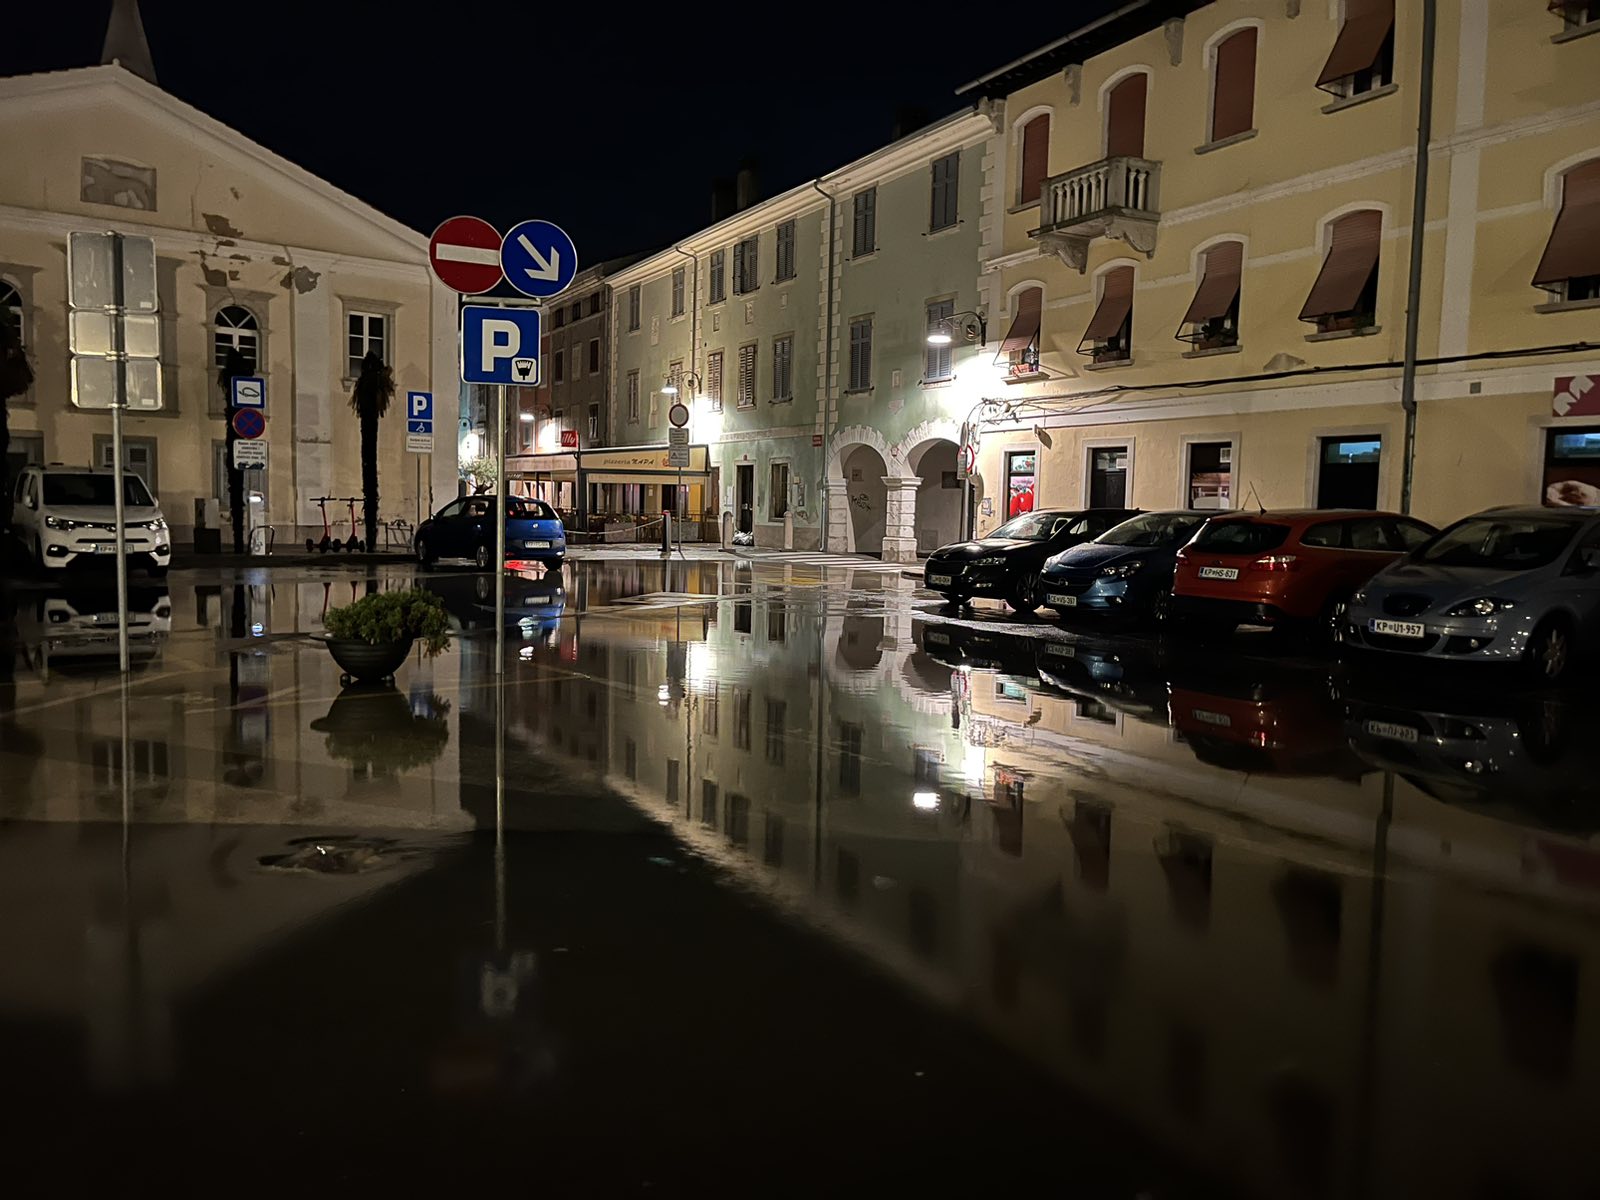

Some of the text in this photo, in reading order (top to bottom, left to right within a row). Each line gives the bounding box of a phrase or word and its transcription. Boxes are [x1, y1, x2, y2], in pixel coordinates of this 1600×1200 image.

[481, 318, 521, 372] P
[412, 395, 427, 416] P
[561, 432, 576, 446] illy
[631, 457, 655, 465] NAPA
[1375, 621, 1422, 636] KP U1-957
